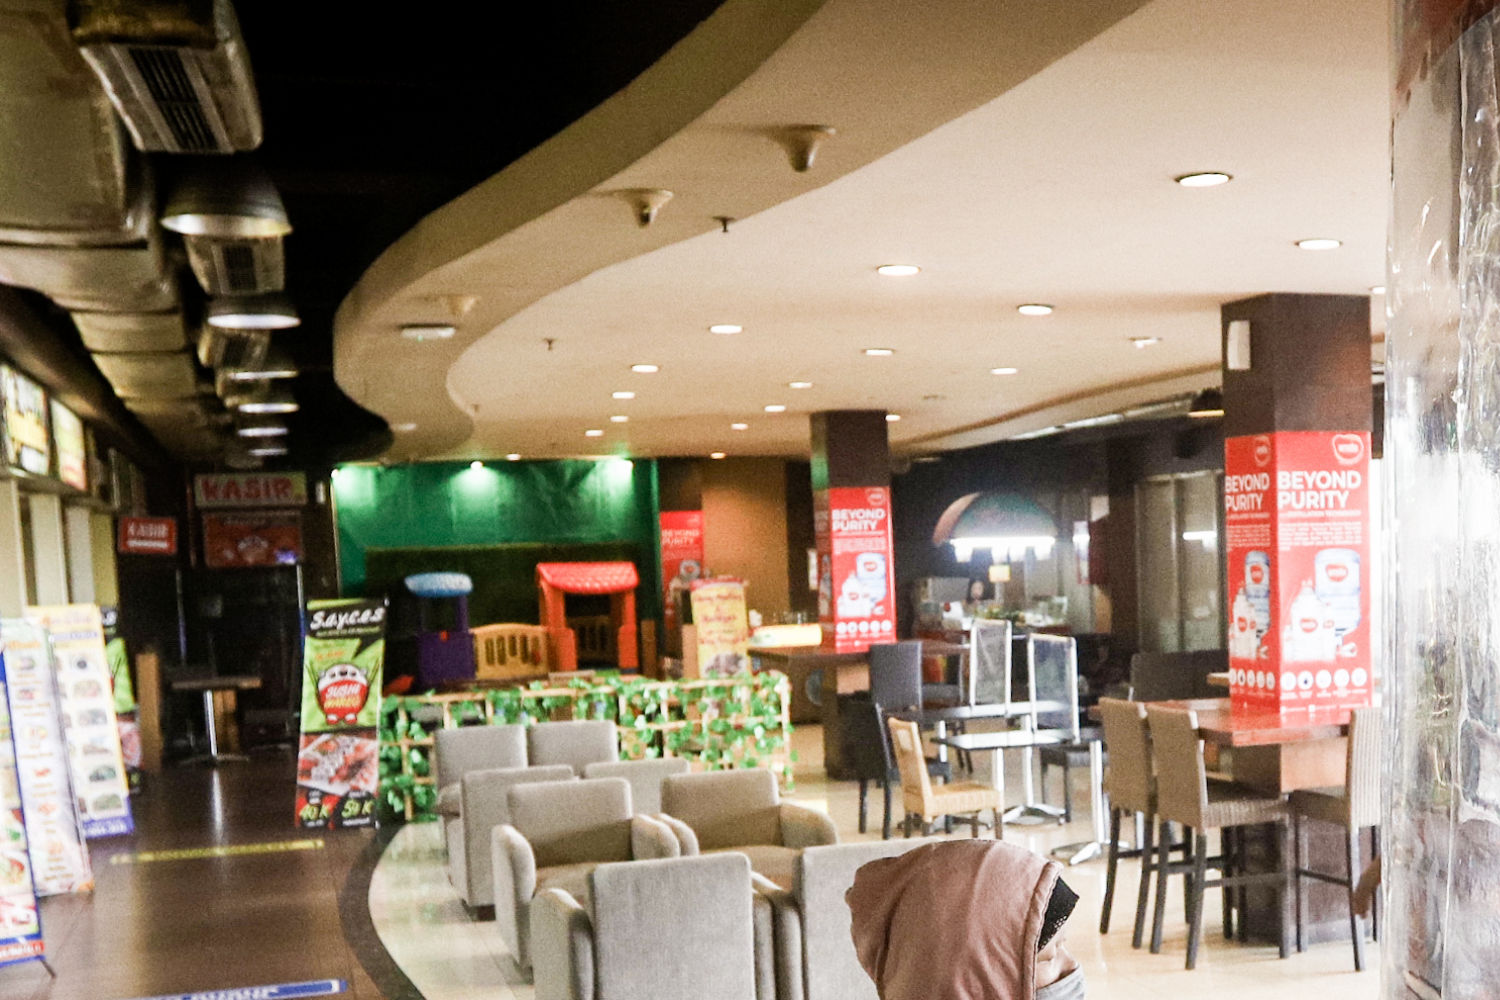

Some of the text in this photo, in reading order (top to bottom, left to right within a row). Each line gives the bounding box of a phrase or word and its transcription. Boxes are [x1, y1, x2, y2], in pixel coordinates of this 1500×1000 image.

[202, 478, 292, 500] KASIR
[1225, 473, 1270, 493] BEYOND
[1277, 470, 1362, 490] BEYOND
[1225, 493, 1264, 511] PURITY
[1277, 490, 1349, 510] PURITY
[831, 508, 886, 520] BEYOND
[831, 520, 878, 532] PURITY
